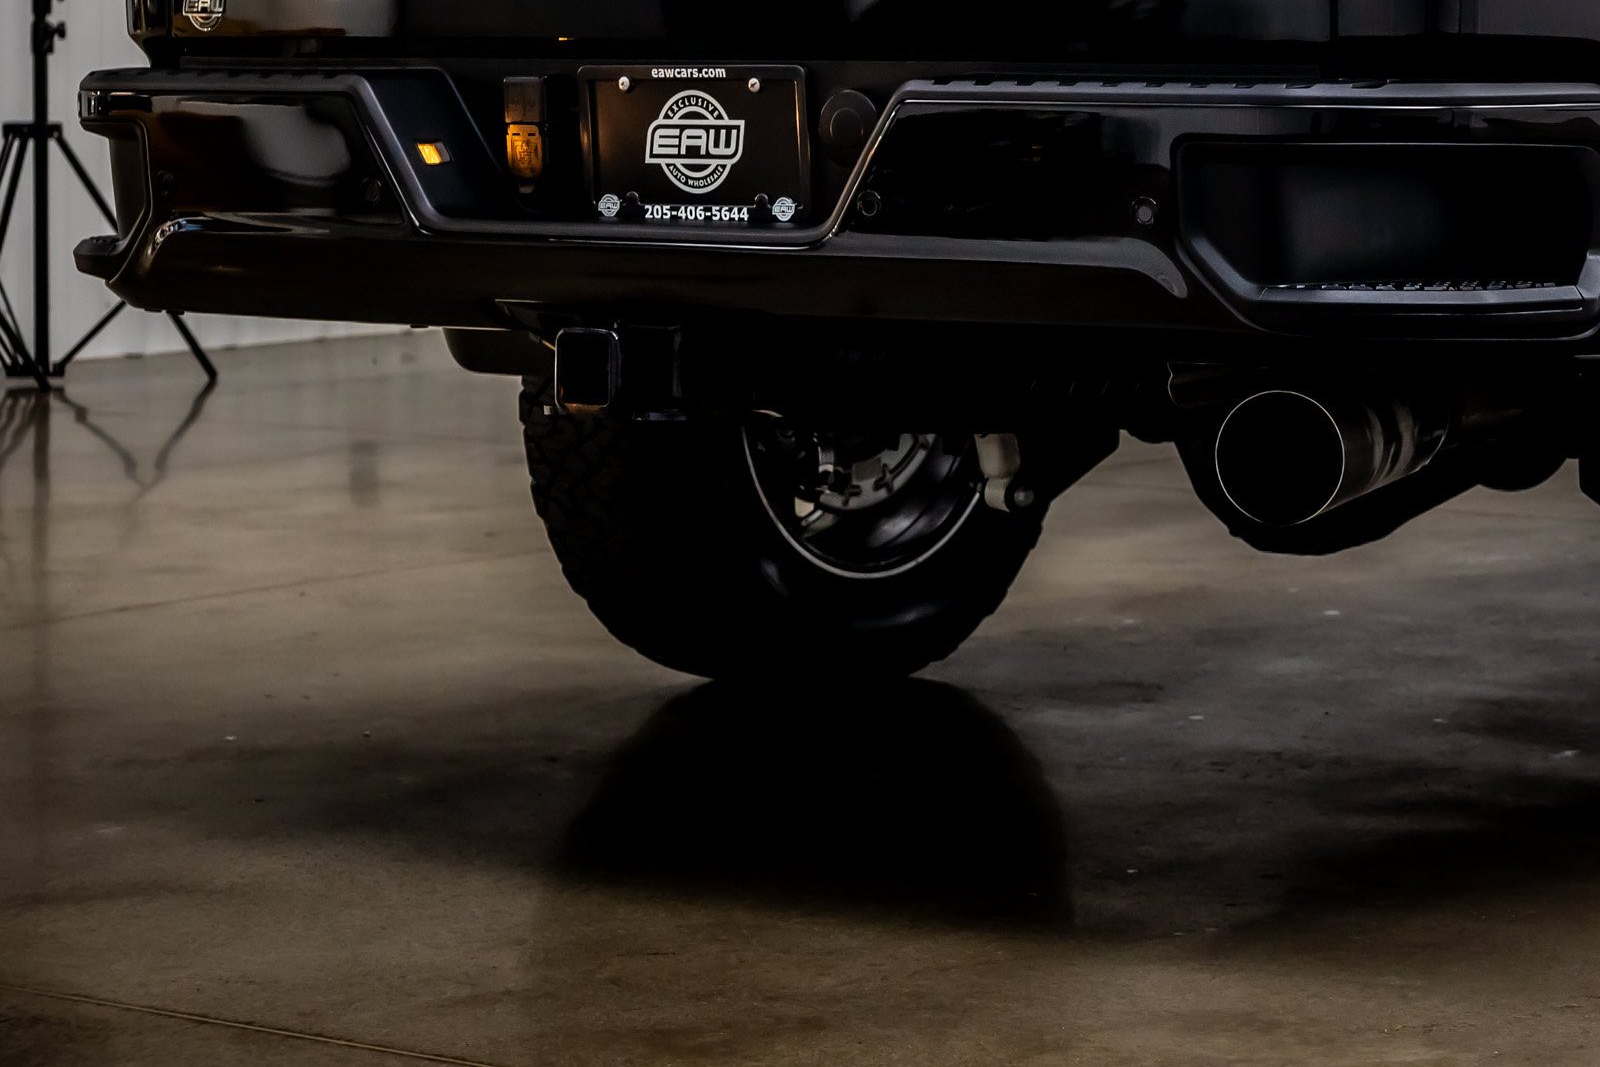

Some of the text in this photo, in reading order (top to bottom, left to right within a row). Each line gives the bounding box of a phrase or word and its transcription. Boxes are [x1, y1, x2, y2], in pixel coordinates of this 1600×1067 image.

[651, 68, 727, 79] eawcars.com
[667, 96, 720, 119] EXCLUSIVE
[652, 127, 738, 156] EAW
[668, 165, 686, 183] AUTO
[687, 165, 724, 188] WHOLESALE
[644, 204, 750, 221] 205-406-5644
